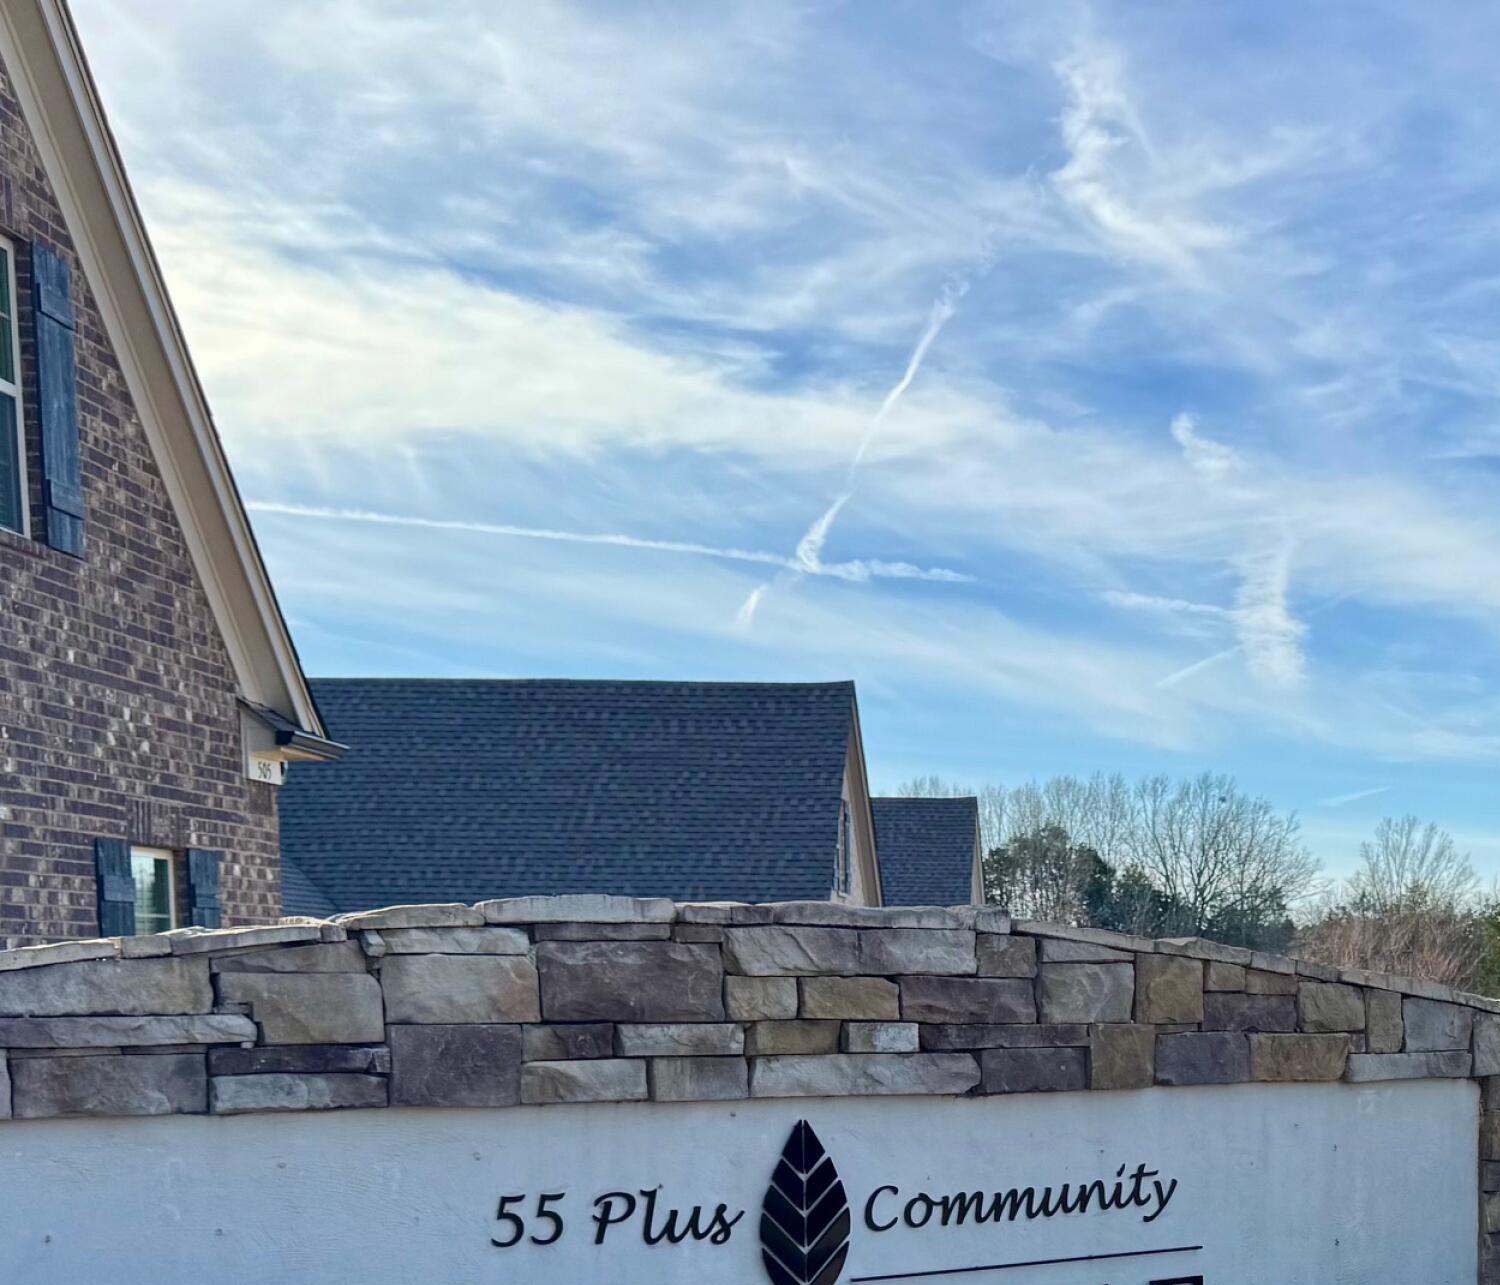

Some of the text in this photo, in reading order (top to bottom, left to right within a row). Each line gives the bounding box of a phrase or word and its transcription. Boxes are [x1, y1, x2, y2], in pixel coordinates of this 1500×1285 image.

[490, 1162, 1178, 1248] 55 Plus Community
